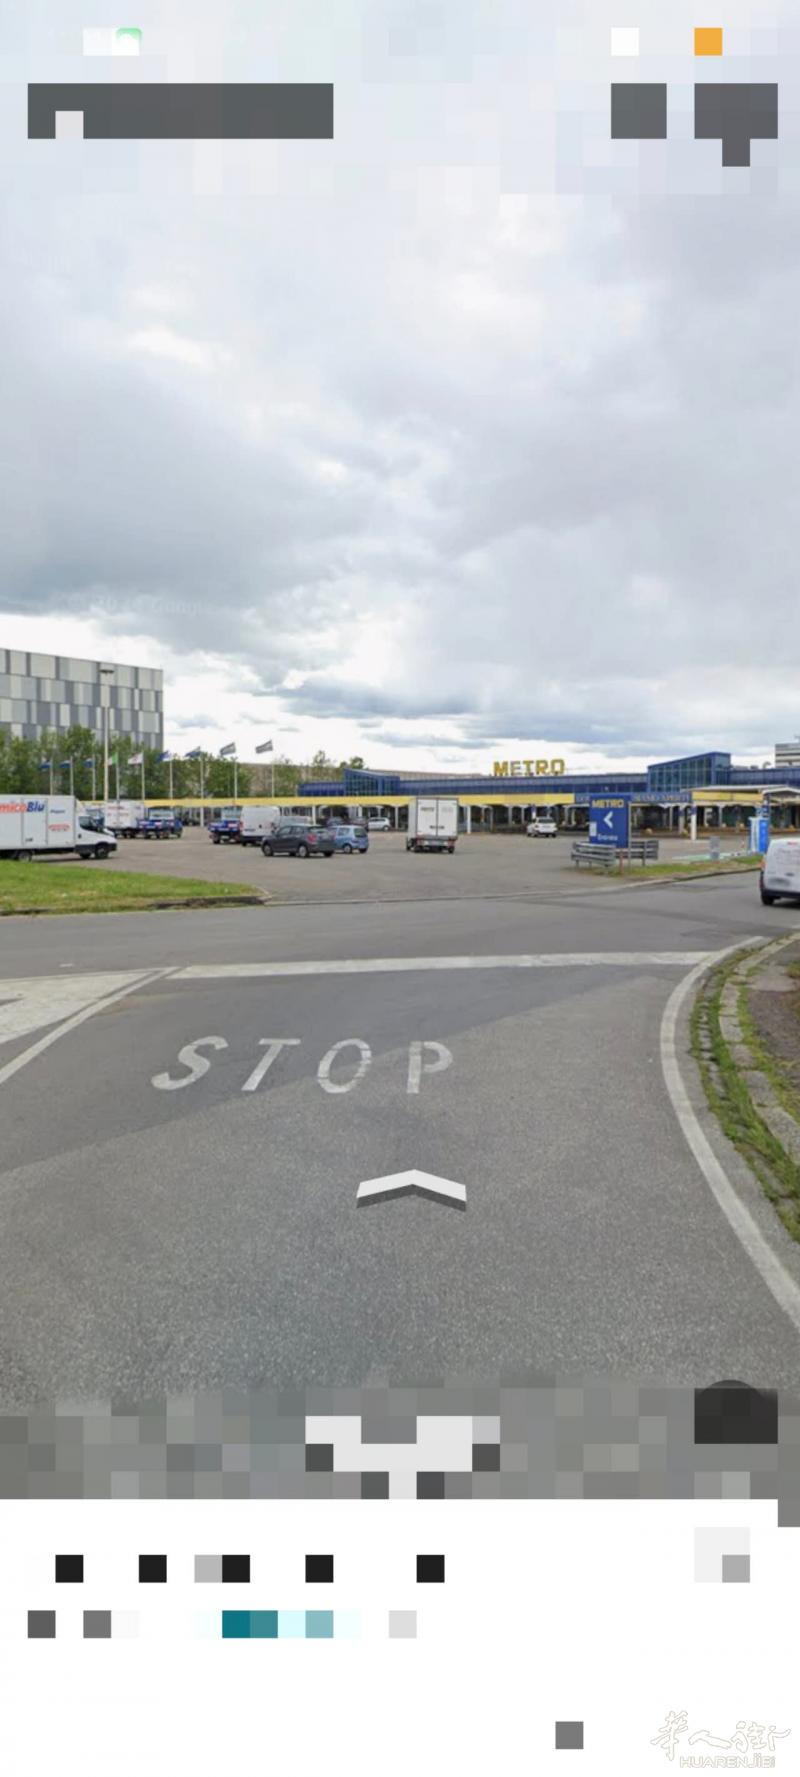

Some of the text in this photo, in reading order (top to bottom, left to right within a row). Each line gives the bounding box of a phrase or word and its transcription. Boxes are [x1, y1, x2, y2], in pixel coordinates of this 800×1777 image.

[493, 758, 565, 776] METRO
[591, 799, 624, 809] METRO
[150, 1035, 454, 1094] STOP
